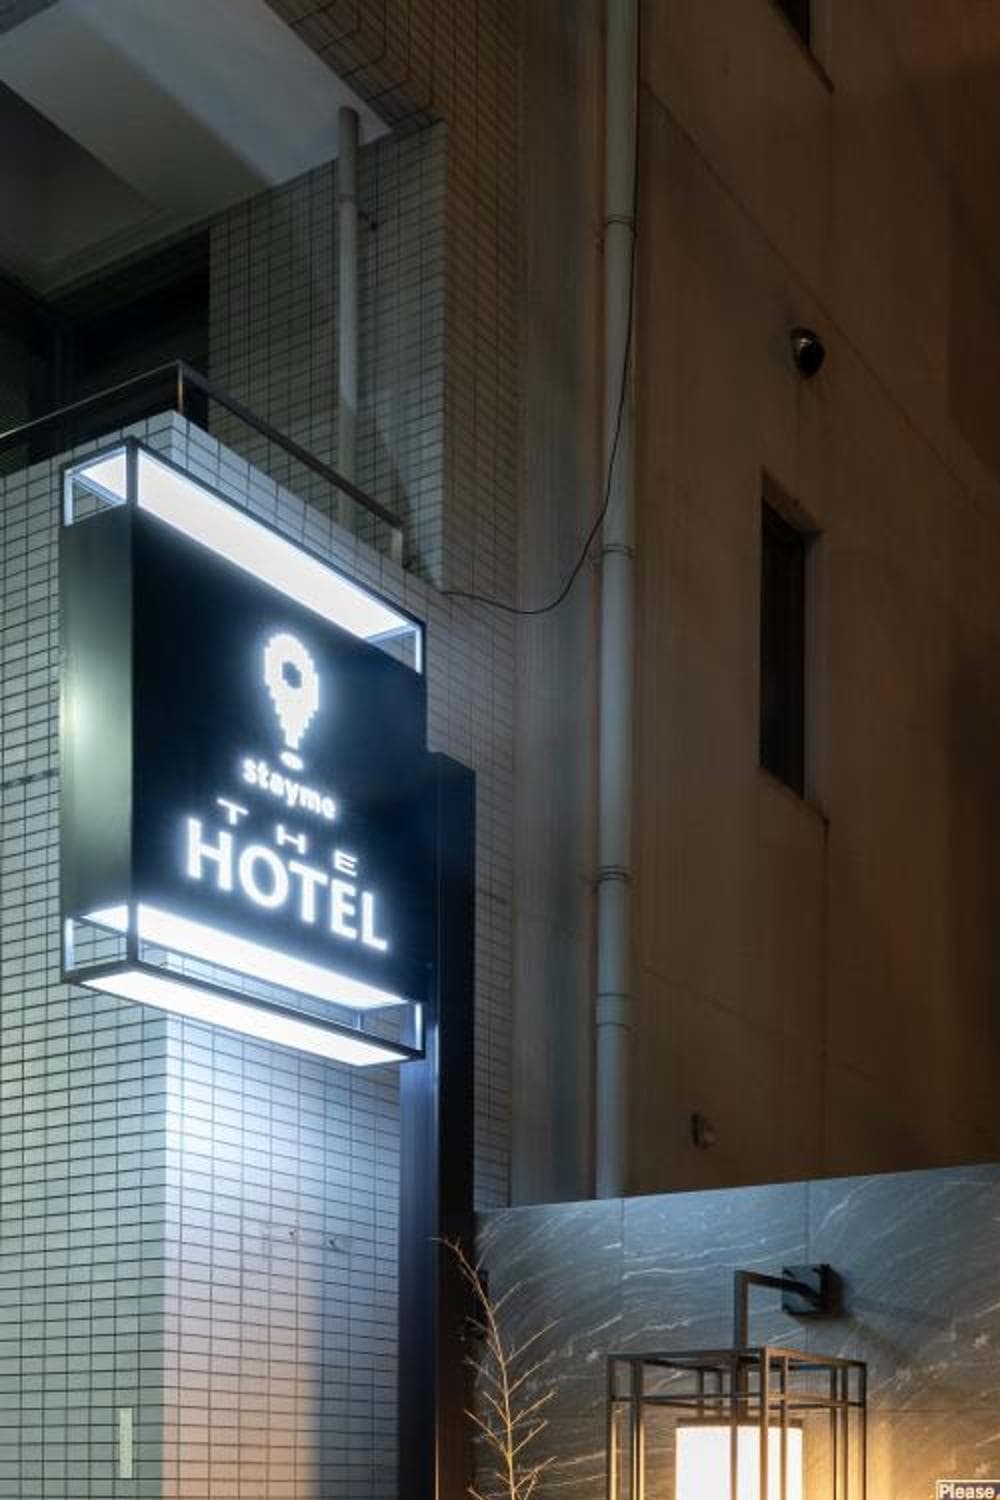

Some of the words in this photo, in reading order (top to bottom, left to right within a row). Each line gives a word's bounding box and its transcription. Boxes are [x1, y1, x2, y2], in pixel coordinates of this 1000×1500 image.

[242, 758, 337, 820] stayme
[217, 798, 360, 877] THE
[185, 817, 389, 952] HOTEL
[939, 1483, 995, 1499] Please
